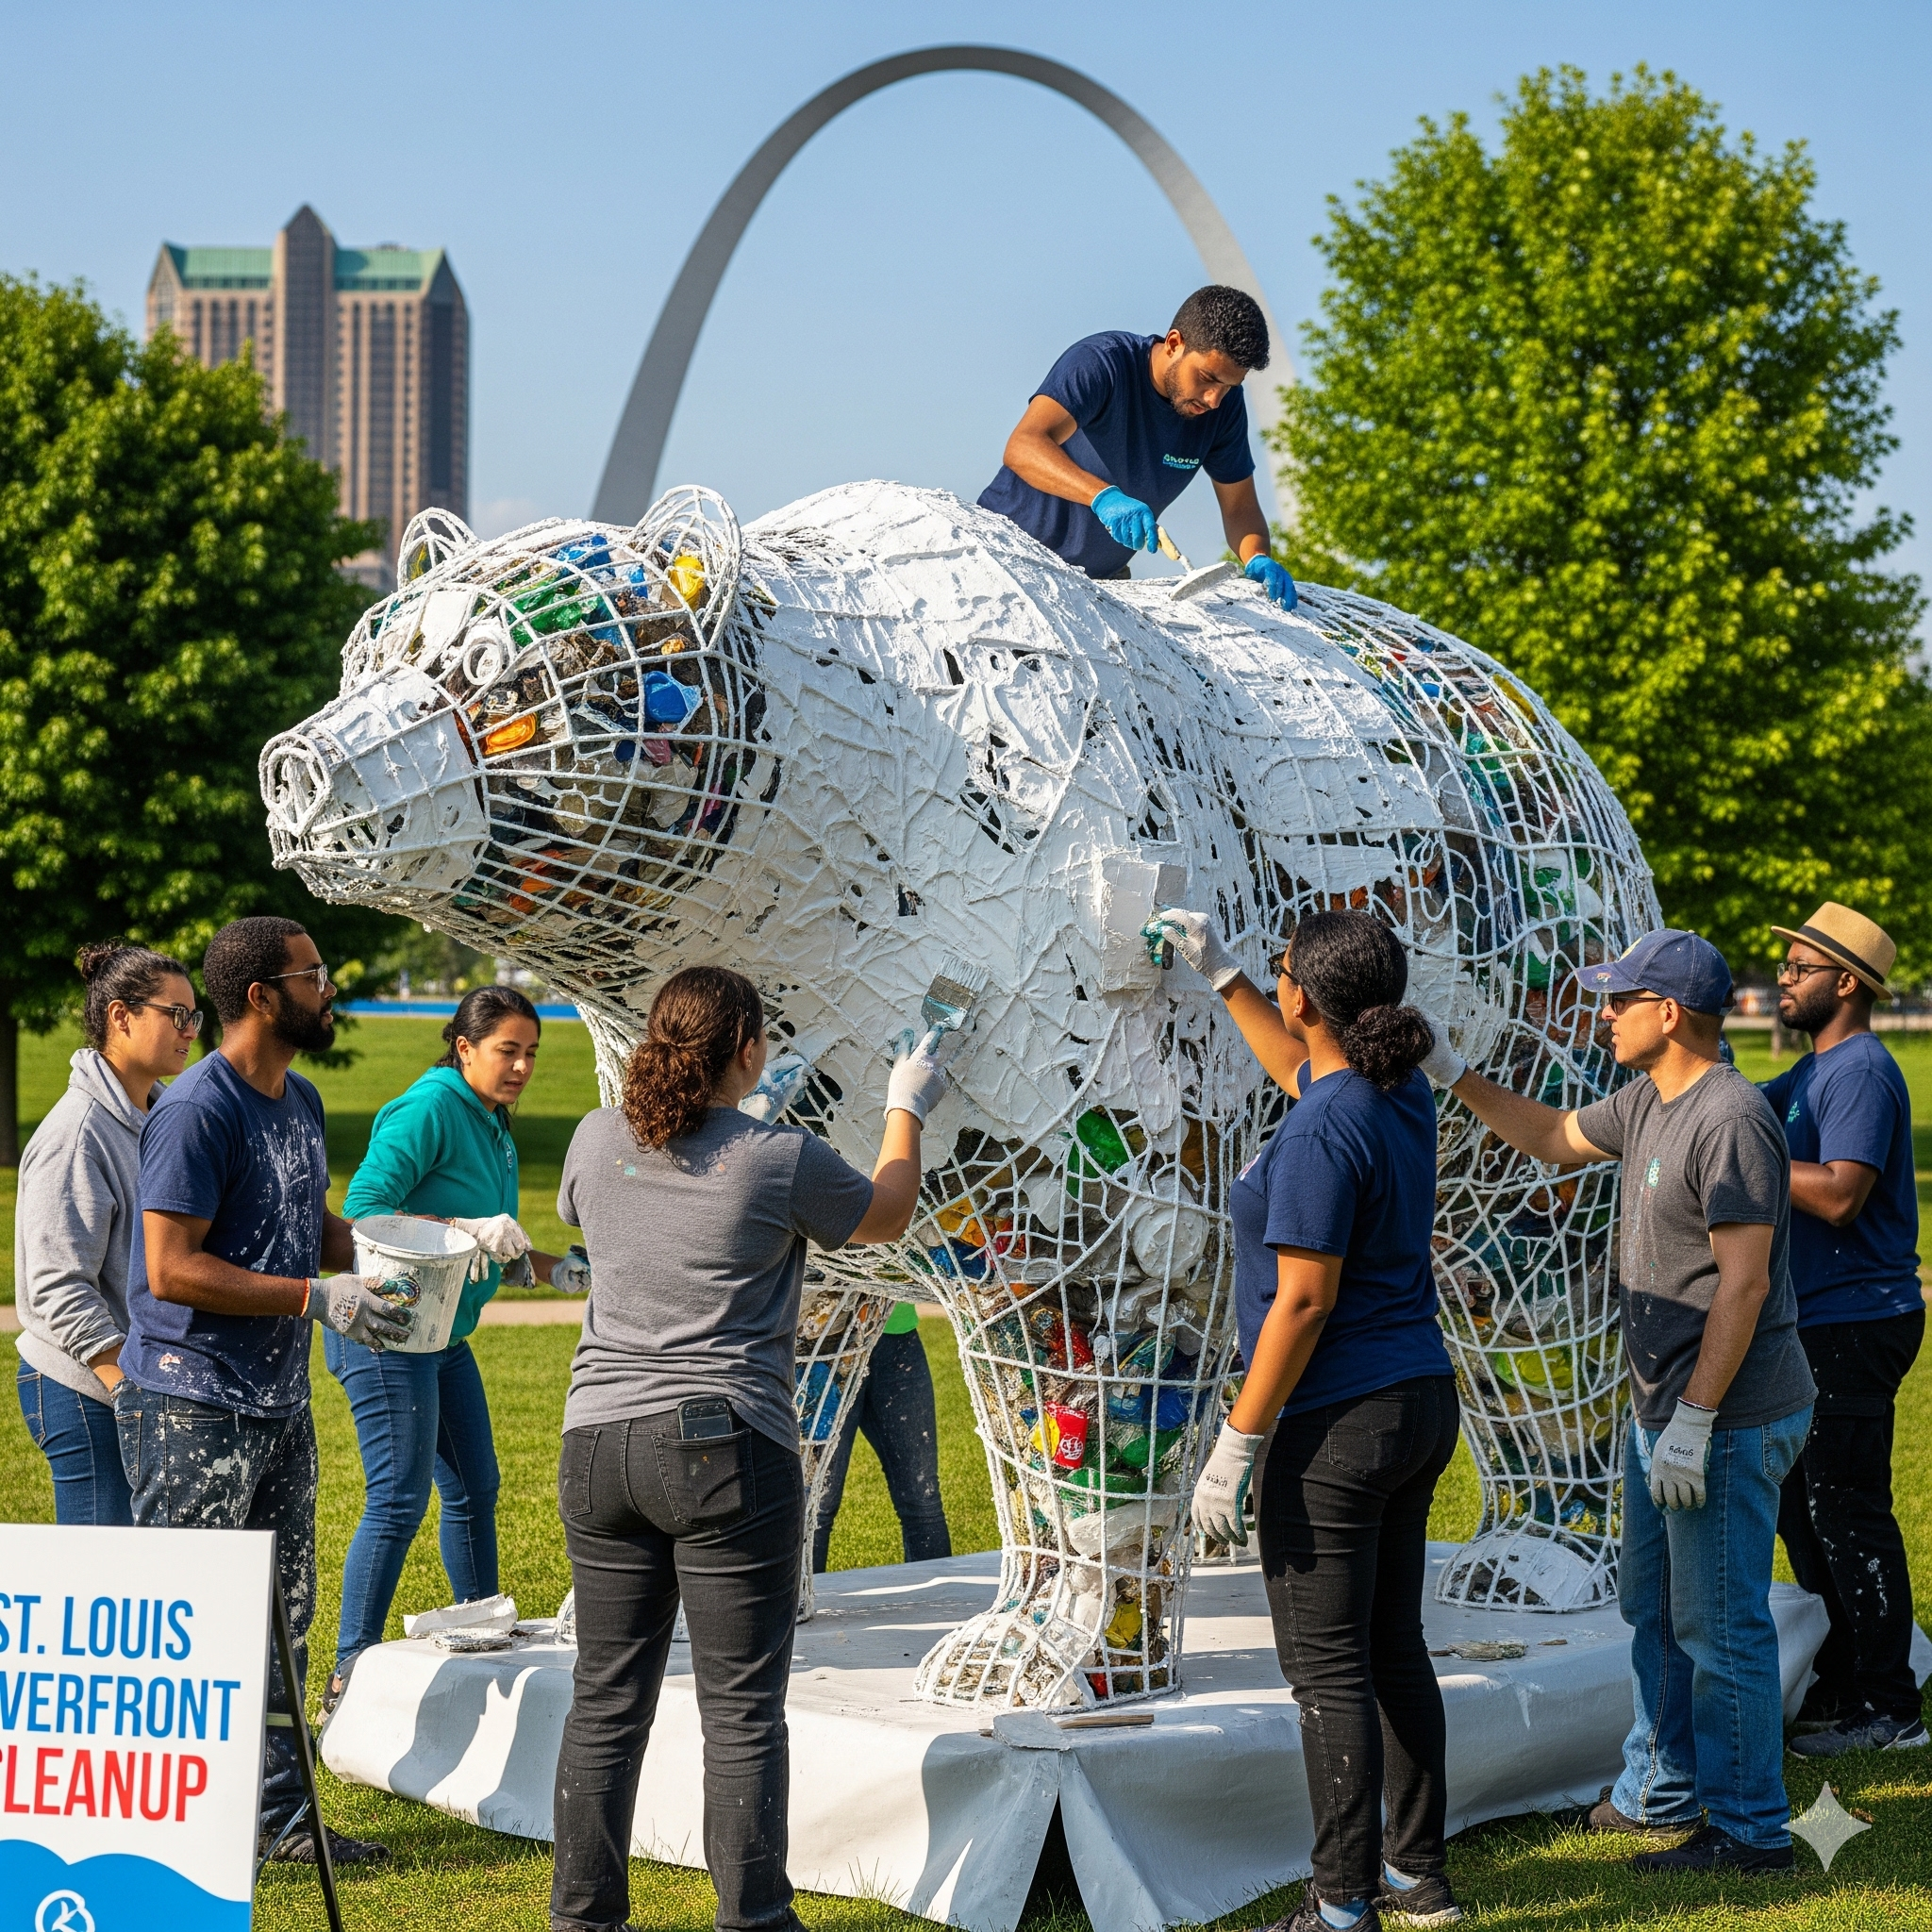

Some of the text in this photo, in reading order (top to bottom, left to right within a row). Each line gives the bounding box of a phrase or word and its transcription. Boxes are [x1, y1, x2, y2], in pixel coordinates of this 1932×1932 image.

[62, 1596, 193, 1660] LOUIS
[0, 1671, 241, 1741] VERFRONT
[0, 1745, 208, 1823] LEANUP
